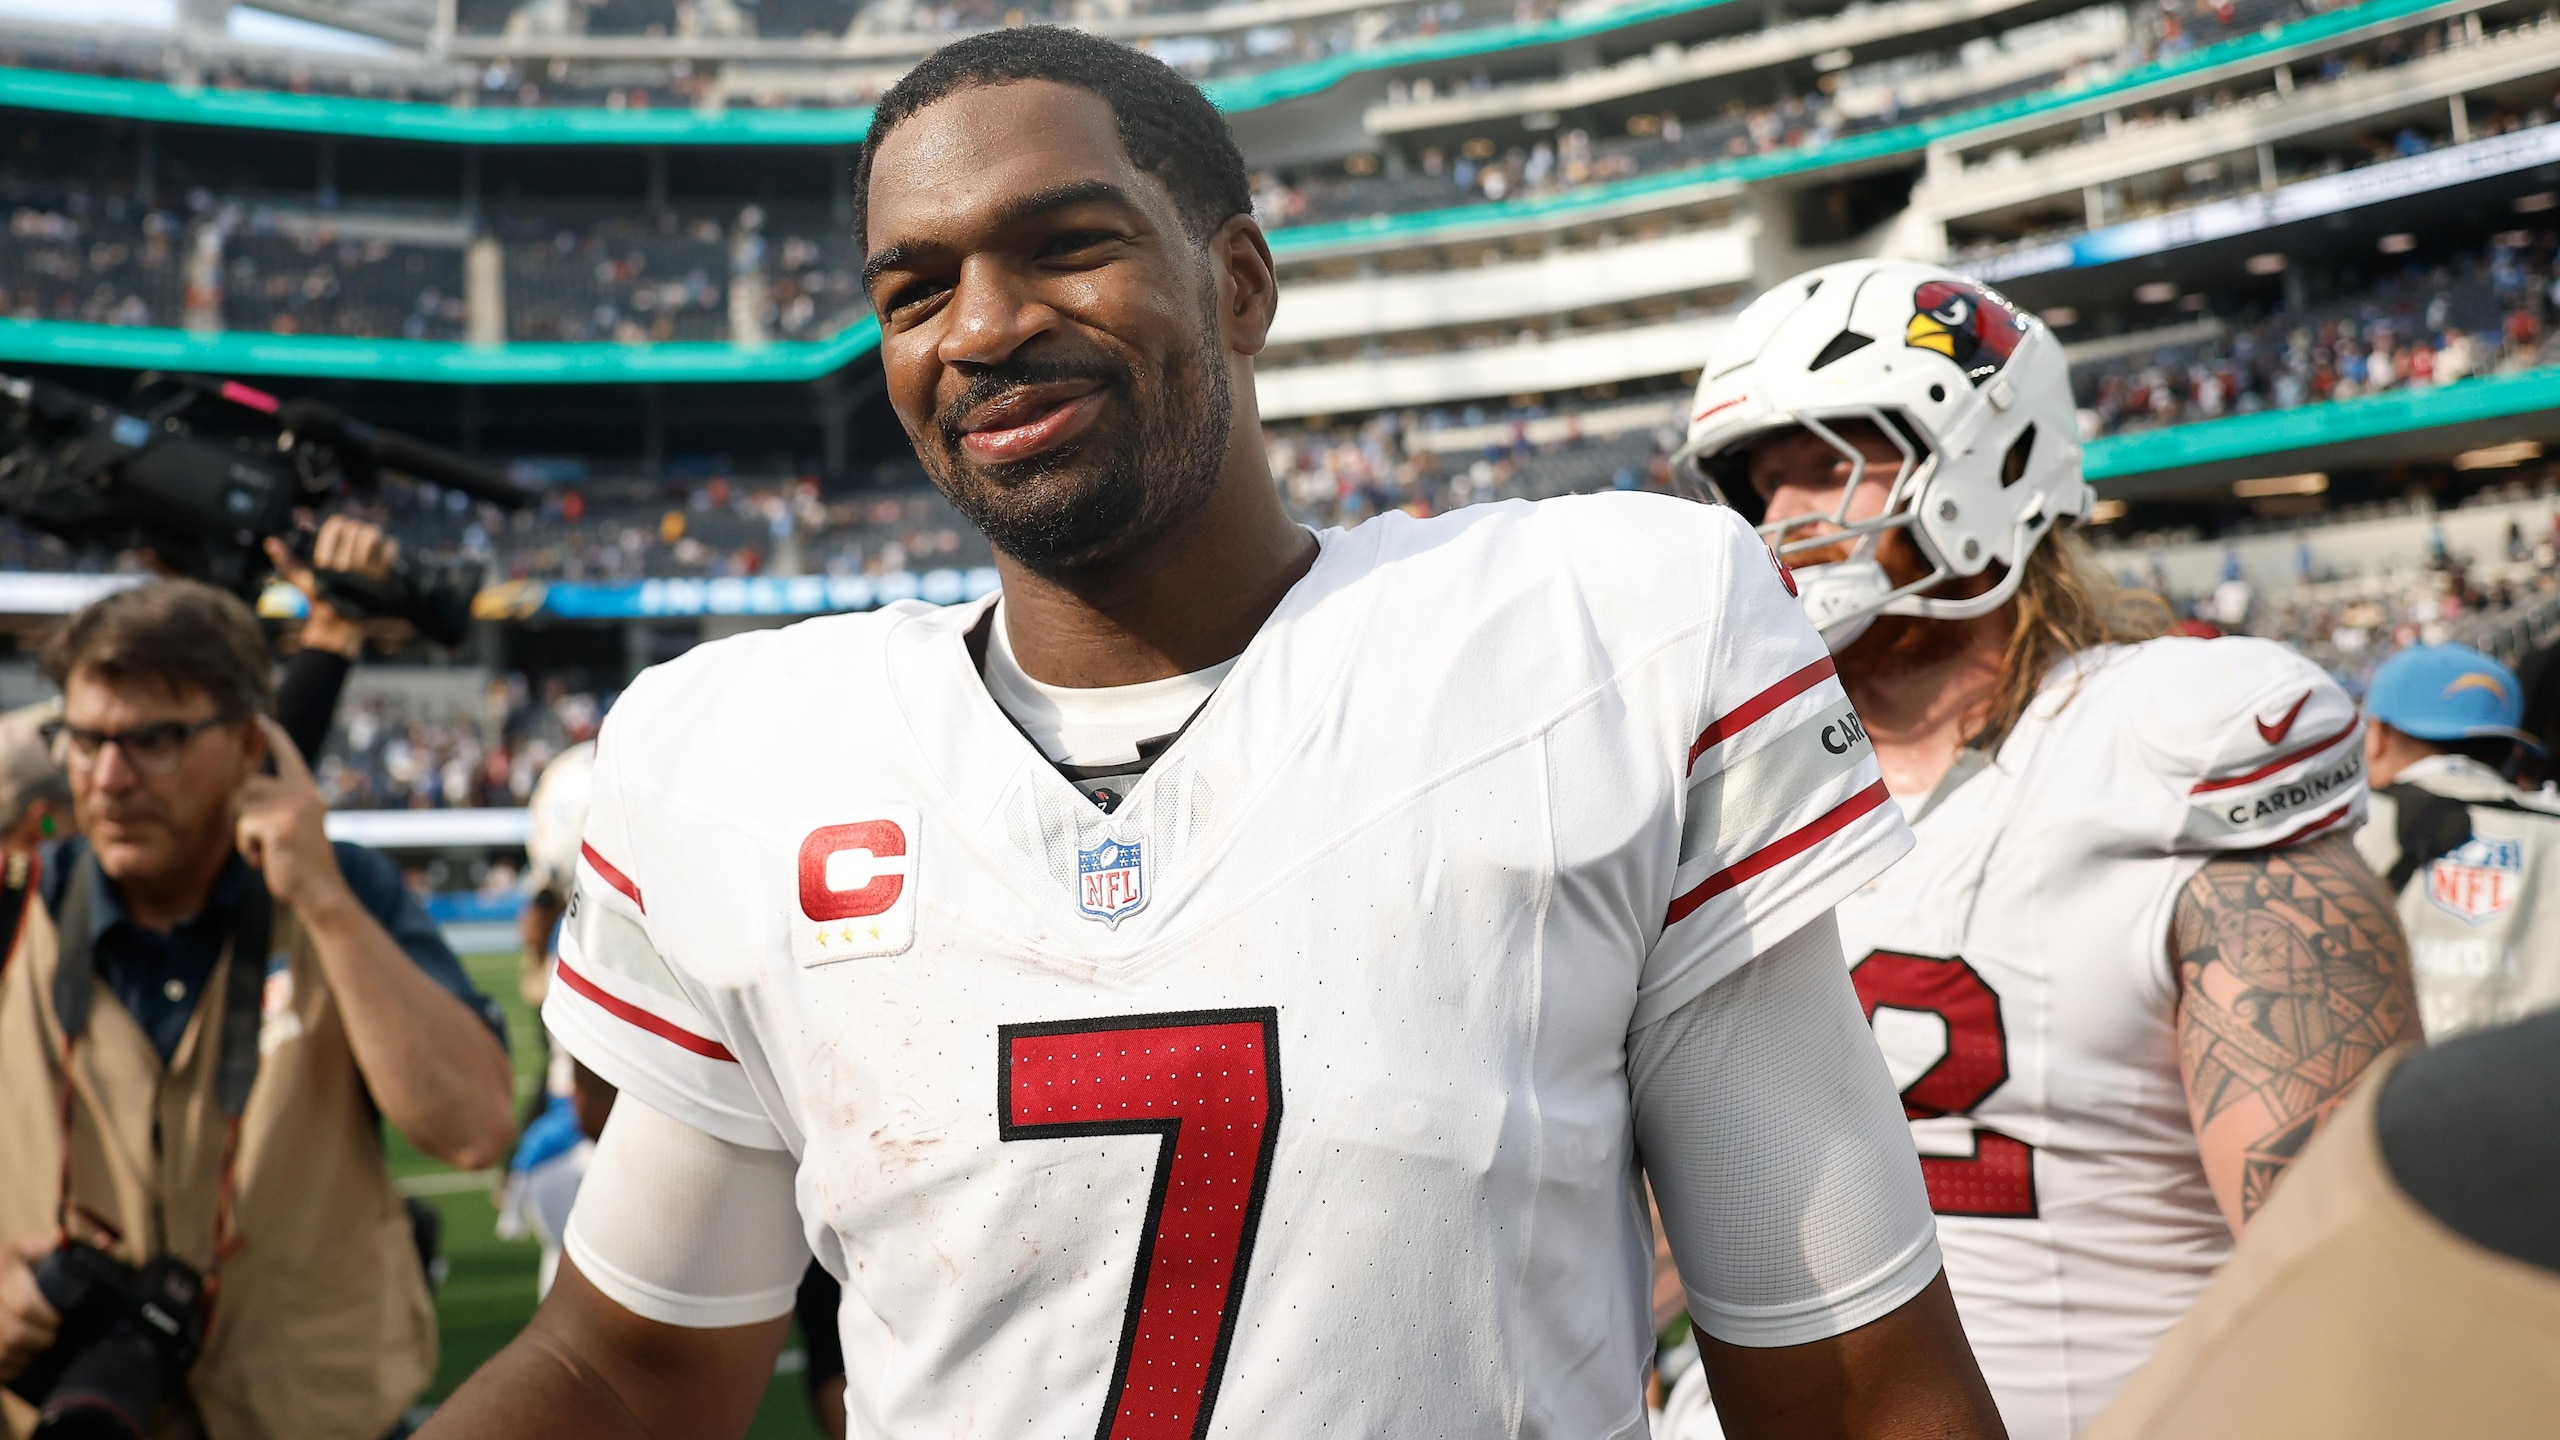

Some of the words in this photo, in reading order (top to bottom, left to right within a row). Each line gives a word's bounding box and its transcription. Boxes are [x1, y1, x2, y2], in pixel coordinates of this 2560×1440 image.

[2230, 753, 2361, 824] CARDINALS
[799, 819, 906, 922] C
[1085, 871, 1138, 909] NFL
[2434, 866, 2514, 911] NFL
[1848, 948, 2039, 1219] 2
[998, 1006, 1284, 1440] 7
